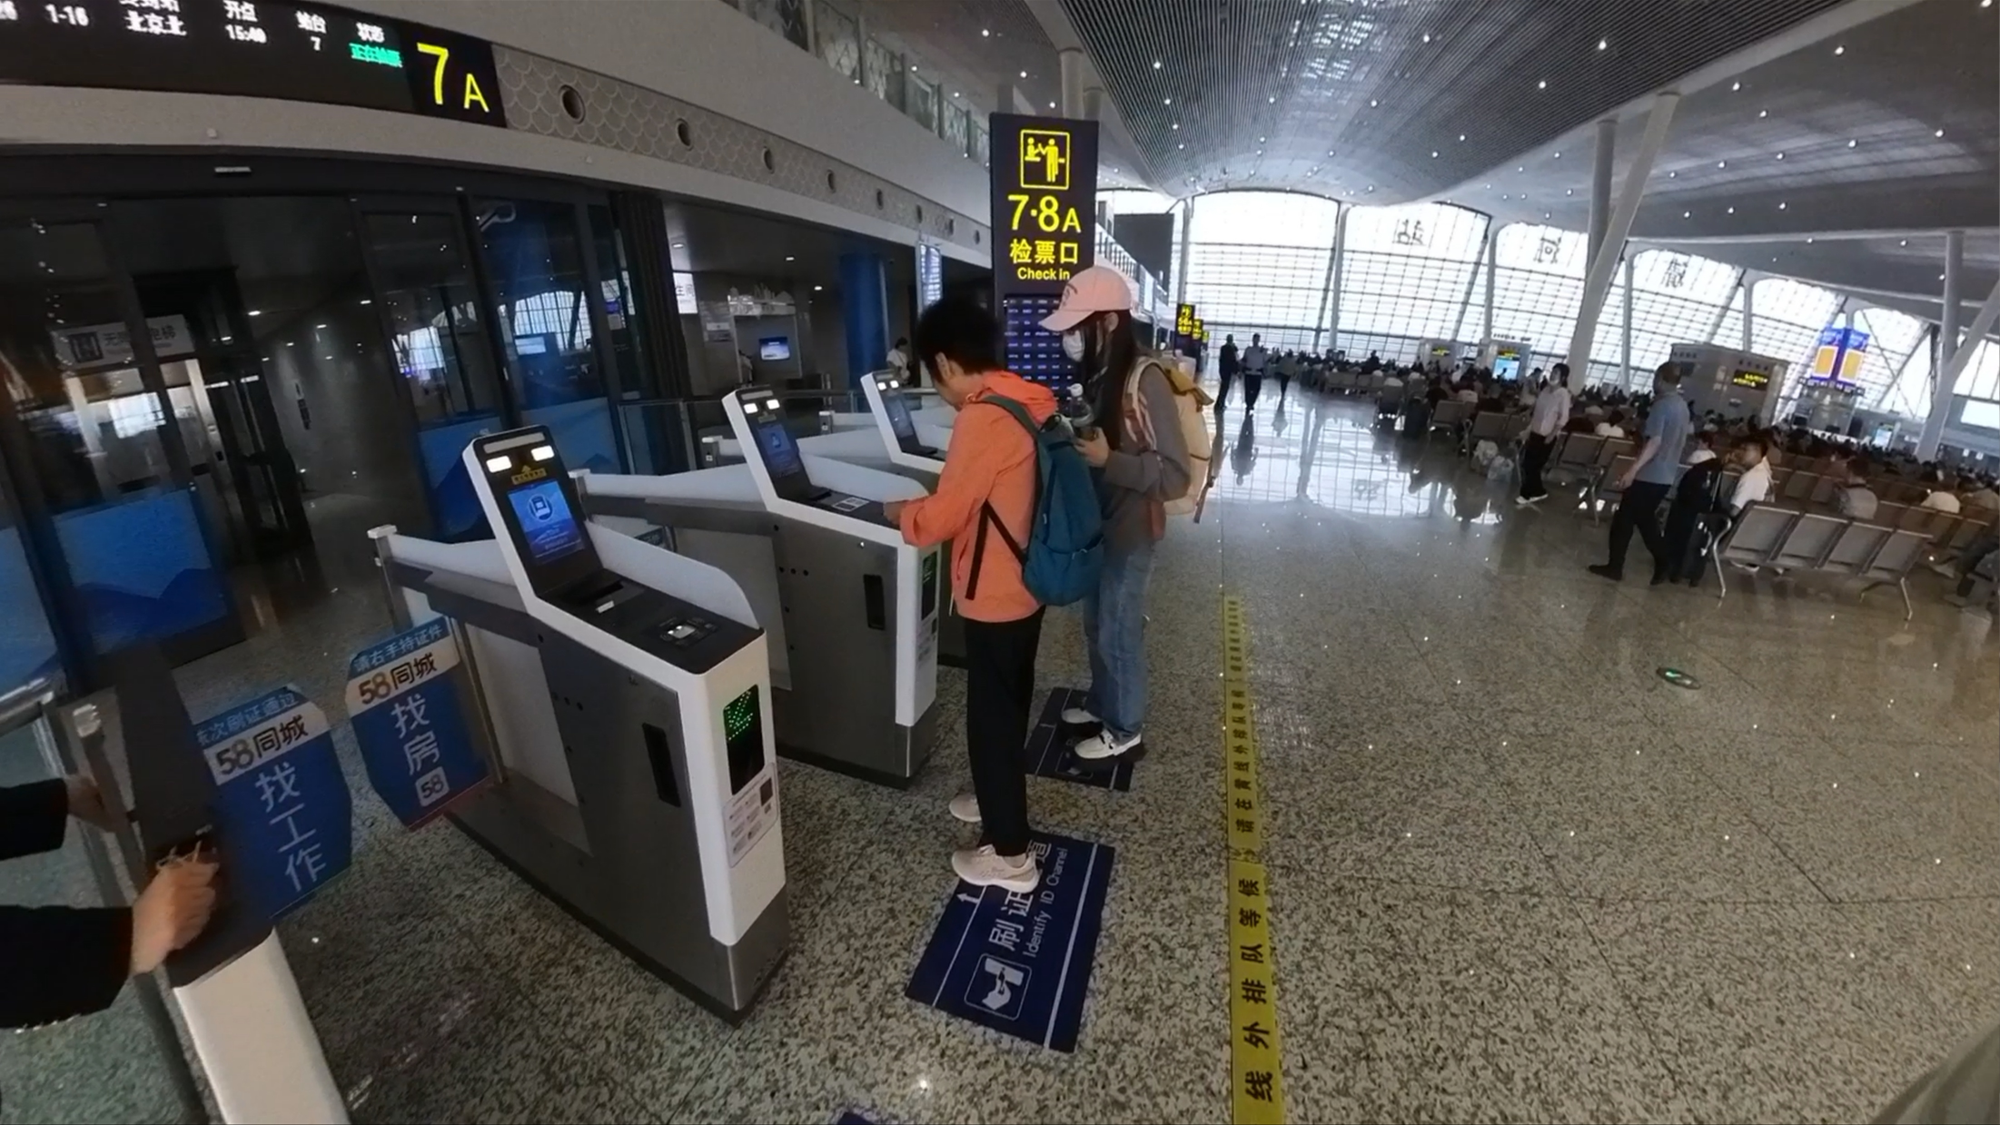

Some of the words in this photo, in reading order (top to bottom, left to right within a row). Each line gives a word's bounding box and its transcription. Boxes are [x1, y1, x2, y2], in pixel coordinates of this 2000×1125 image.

[124, 10, 187, 36] 北京北
[311, 36, 321, 51] 7
[1009, 238, 1079, 264] 检票口
[1017, 267, 1057, 281] Check
[1059, 268, 1071, 281] in
[358, 652, 438, 706] 58同城
[216, 714, 309, 776] 58同城
[390, 693, 441, 777] 找房
[1231, 689, 1255, 834] 请在黄线外排队等候
[420, 776, 446, 799] 58
[254, 761, 328, 893] 找工作
[988, 841, 1053, 953] 刷证道
[1022, 909, 1053, 959] Identify
[1039, 889, 1056, 906] ID
[1049, 847, 1068, 887] Channel
[1237, 877, 1274, 1104] 线外排队等候
